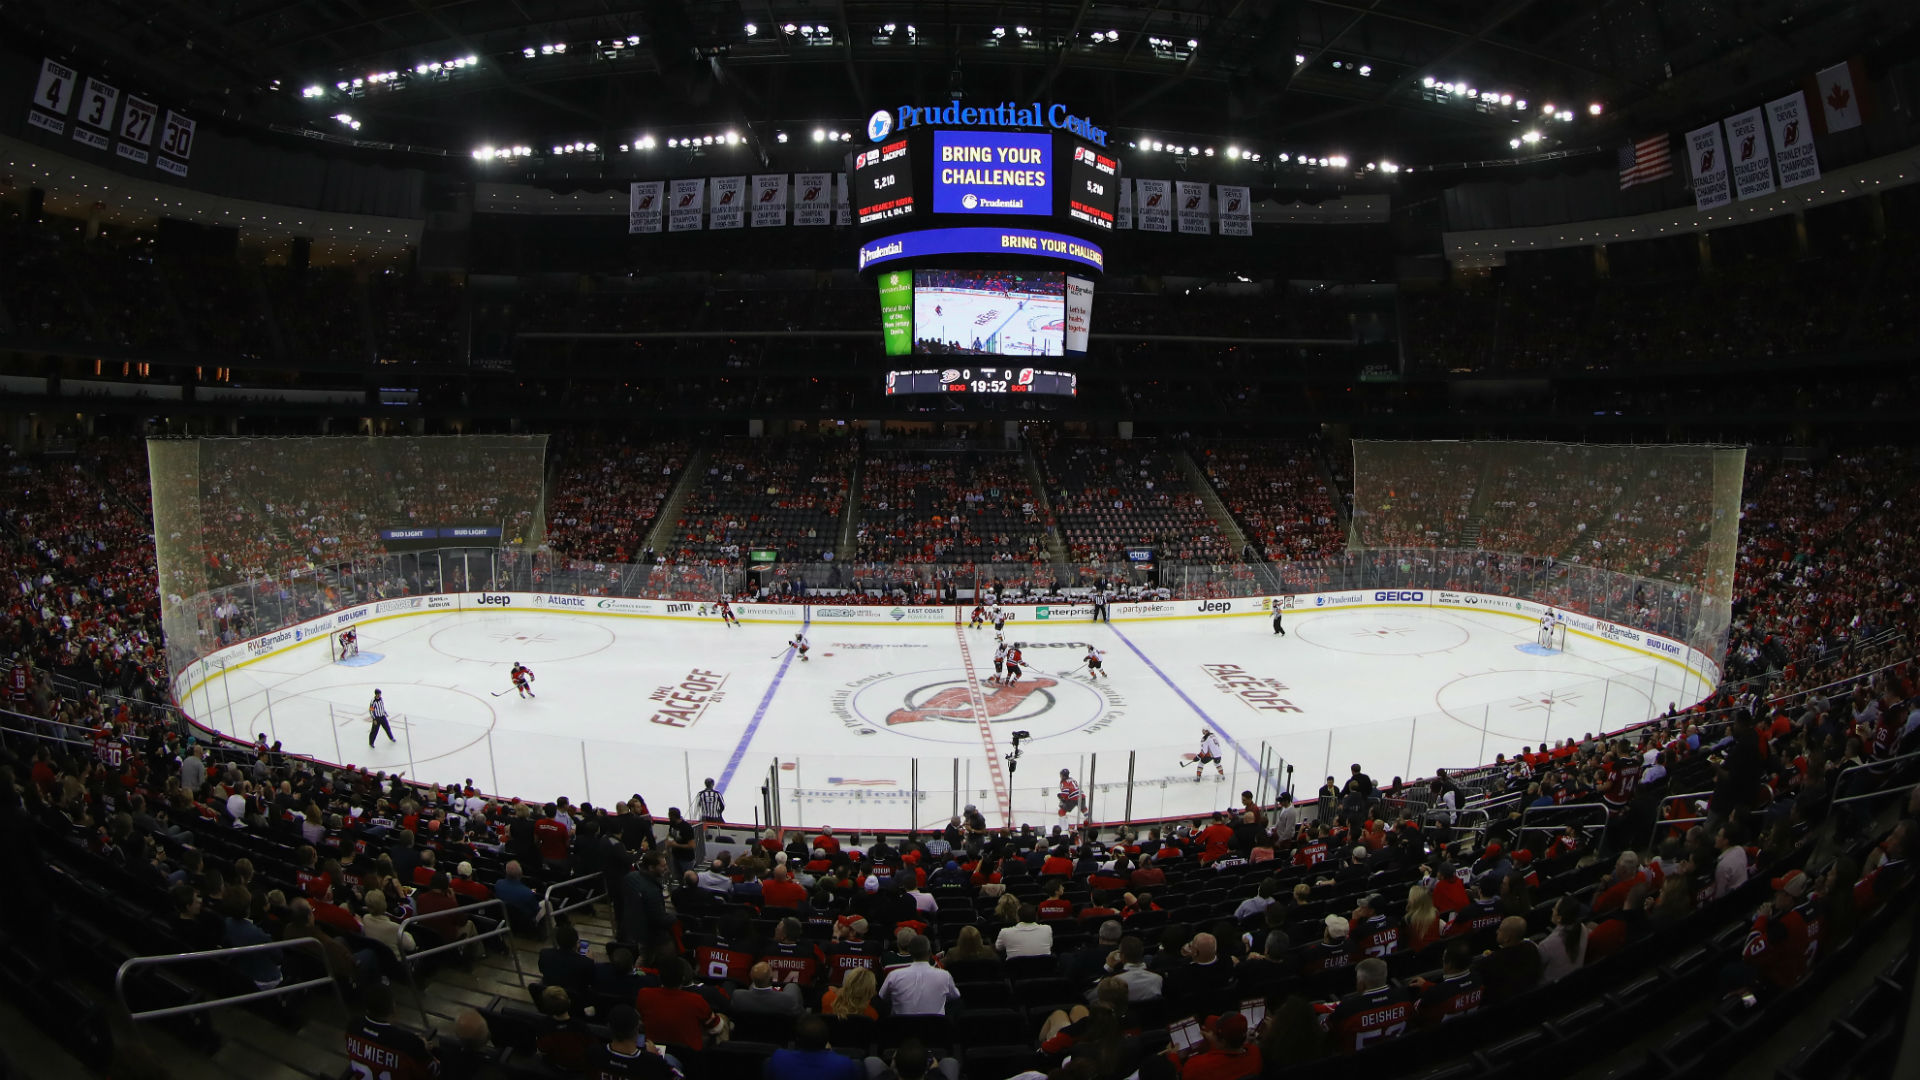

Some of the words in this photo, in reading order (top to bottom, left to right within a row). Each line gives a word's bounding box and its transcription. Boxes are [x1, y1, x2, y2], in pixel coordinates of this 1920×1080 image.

[47, 78, 62, 109] 4
[89, 94, 106, 125] 3
[1776, 108, 1798, 122] DEVILS
[125, 108, 151, 142] 27
[896, 100, 1044, 132] Prudential
[1048, 104, 1108, 148] Center
[1735, 124, 1755, 137] DEVILS
[164, 122, 192, 157] 30
[1695, 138, 1714, 151] DEVILS
[882, 148, 906, 161] JACKPOT
[942, 146, 992, 163] BRING
[997, 147, 1042, 164] YOUR
[1777, 147, 1801, 162] STANLEY
[1802, 143, 1814, 154] CUP
[1734, 162, 1757, 176] STANLEY
[1758, 157, 1769, 169] CUP
[1780, 155, 1815, 174] CHAMPIONS
[874, 174, 895, 189] 5,210
[942, 169, 1046, 187] CHALLENGES
[1694, 174, 1715, 188] STANLEY
[1715, 170, 1726, 182] CUP
[1737, 169, 1770, 187] CHAMPIONS
[1086, 180, 1104, 196] 5,210
[1697, 181, 1727, 198] CHAMPIONS
[980, 197, 1023, 208] Prudential
[866, 241, 903, 262] Prudential
[1001, 235, 1037, 249] BRING
[1040, 238, 1067, 254] YOUR
[963, 369, 970, 379] 0
[1004, 370, 1012, 380] 0
[970, 381, 1007, 392] 19:52
[477, 593, 511, 607] Jeep
[548, 595, 585, 607] Atlantic
[1328, 594, 1363, 605] Prudential
[1375, 591, 1424, 602] GEICO
[1198, 600, 1231, 613] Jeep
[337, 614, 349, 623] BUD
[350, 609, 367, 620] LIGHT
[1565, 616, 1594, 632] Prudential
[304, 620, 332, 637] Prudential
[1647, 638, 1661, 649] BUD
[1661, 643, 1680, 655] LIGHT
[1203, 664, 1304, 713] FACE-OFF
[1260, 678, 1290, 691] NHL
[648, 686, 674, 701] NHL
[650, 668, 722, 728] FACE-OFF
[1373, 929, 1397, 945] ELIAS
[710, 951, 730, 962] HALL
[768, 959, 806, 969] HENRIQUE
[839, 957, 873, 968] GREENE
[1324, 954, 1349, 969] ELIAS
[1455, 990, 1481, 1009] MEYER
[1361, 1006, 1405, 1027] DEISHER
[347, 1036, 399, 1070] PALMIERI
